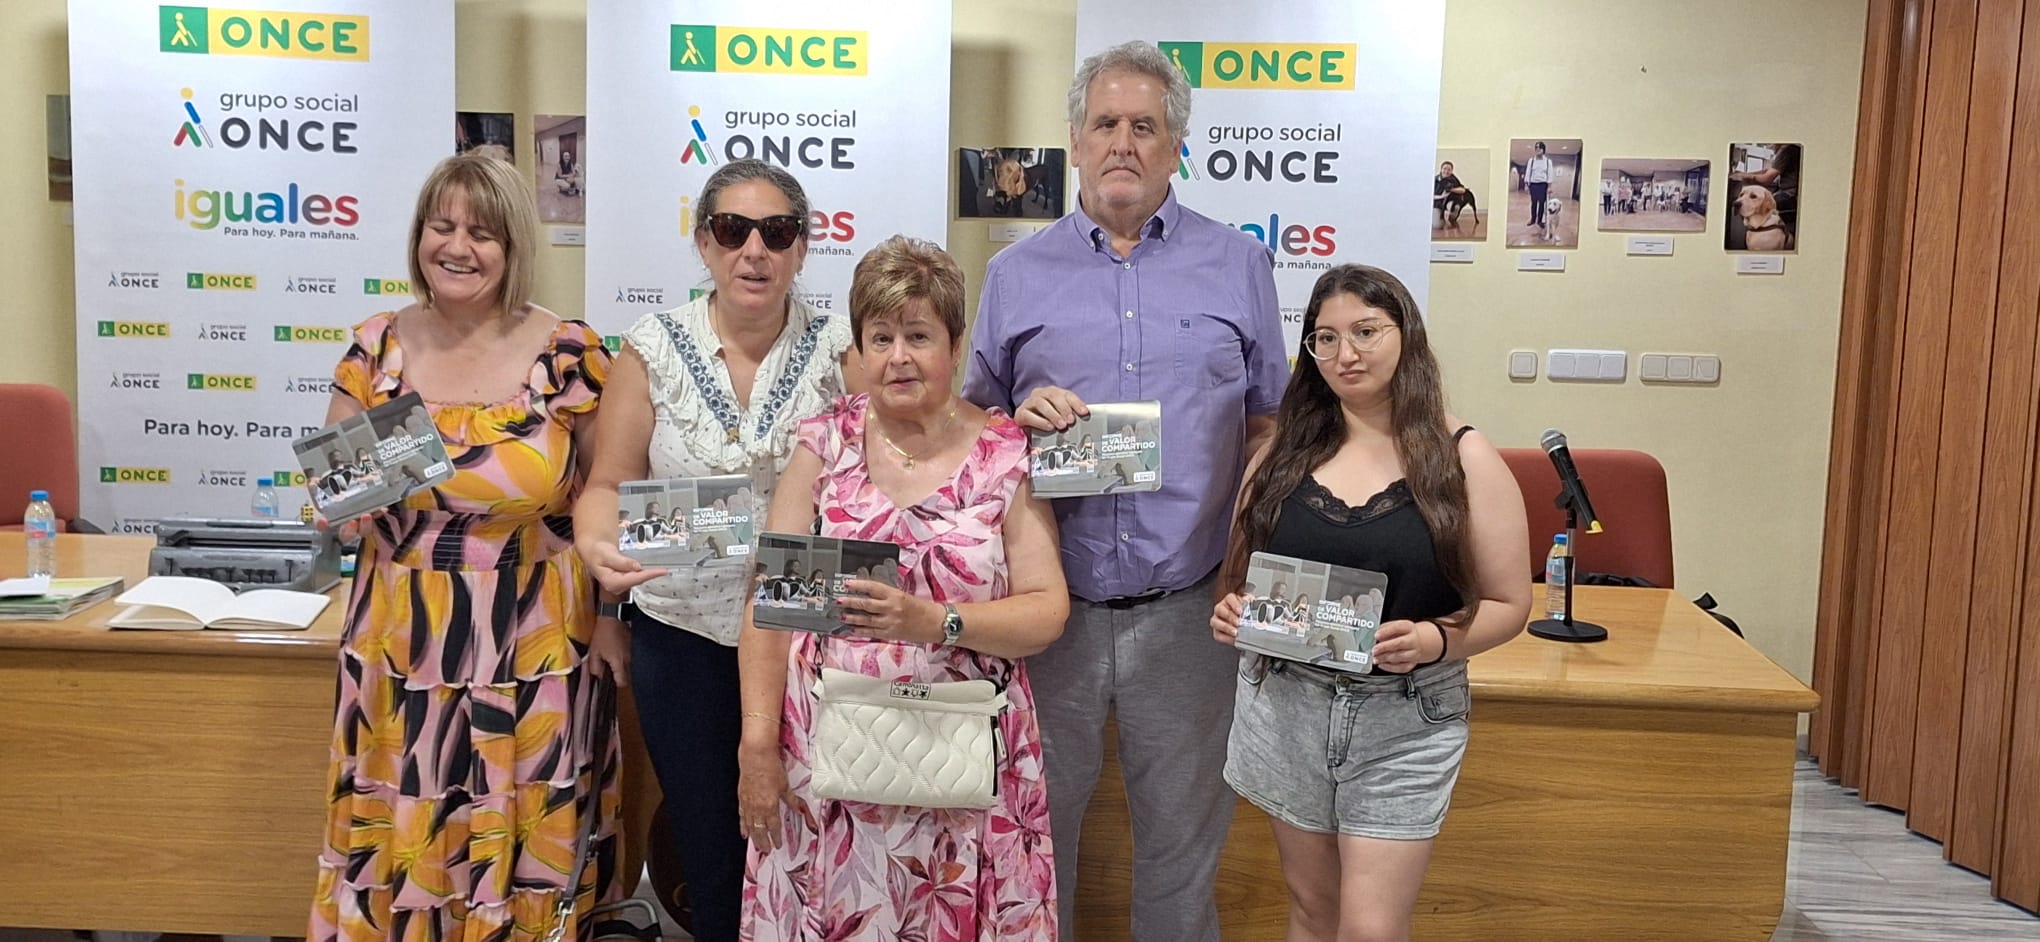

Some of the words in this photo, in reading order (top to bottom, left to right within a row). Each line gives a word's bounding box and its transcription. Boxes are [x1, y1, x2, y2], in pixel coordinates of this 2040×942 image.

[221, 16, 358, 54] ONCE
[727, 34, 857, 69] ONCE
[1213, 50, 1345, 83] ONCE
[220, 92, 288, 112] grupo
[294, 93, 358, 112] social
[725, 110, 789, 129] grupo
[796, 109, 856, 128] social
[220, 117, 358, 154] ONCE
[1208, 125, 1273, 144] grupo
[1279, 123, 1341, 142] social
[724, 134, 855, 169] ONCE
[1206, 150, 1339, 183] ONCE
[174, 178, 360, 230] iguales
[224, 226, 249, 237] Para
[252, 227, 276, 239] hoy.
[280, 229, 306, 239] Para
[310, 230, 359, 241] mañana.
[121, 278, 159, 288] ONCE
[207, 276, 253, 288] ONCE
[298, 284, 336, 294] ONCE
[385, 282, 409, 293] ON
[627, 294, 663, 304] ONCE
[119, 324, 166, 336] ONCE
[210, 331, 246, 341] ONCE
[295, 329, 343, 340] ONCE
[122, 379, 160, 389] ONCE
[208, 377, 253, 388] ONCE
[145, 419, 189, 435] Para
[198, 420, 239, 440] hoy.
[247, 422, 293, 438] Para
[121, 470, 167, 481] ONCE
[210, 477, 246, 487] ONCE
[1325, 604, 1355, 618] VALOR
[1316, 612, 1374, 629] COMPARTIDO
